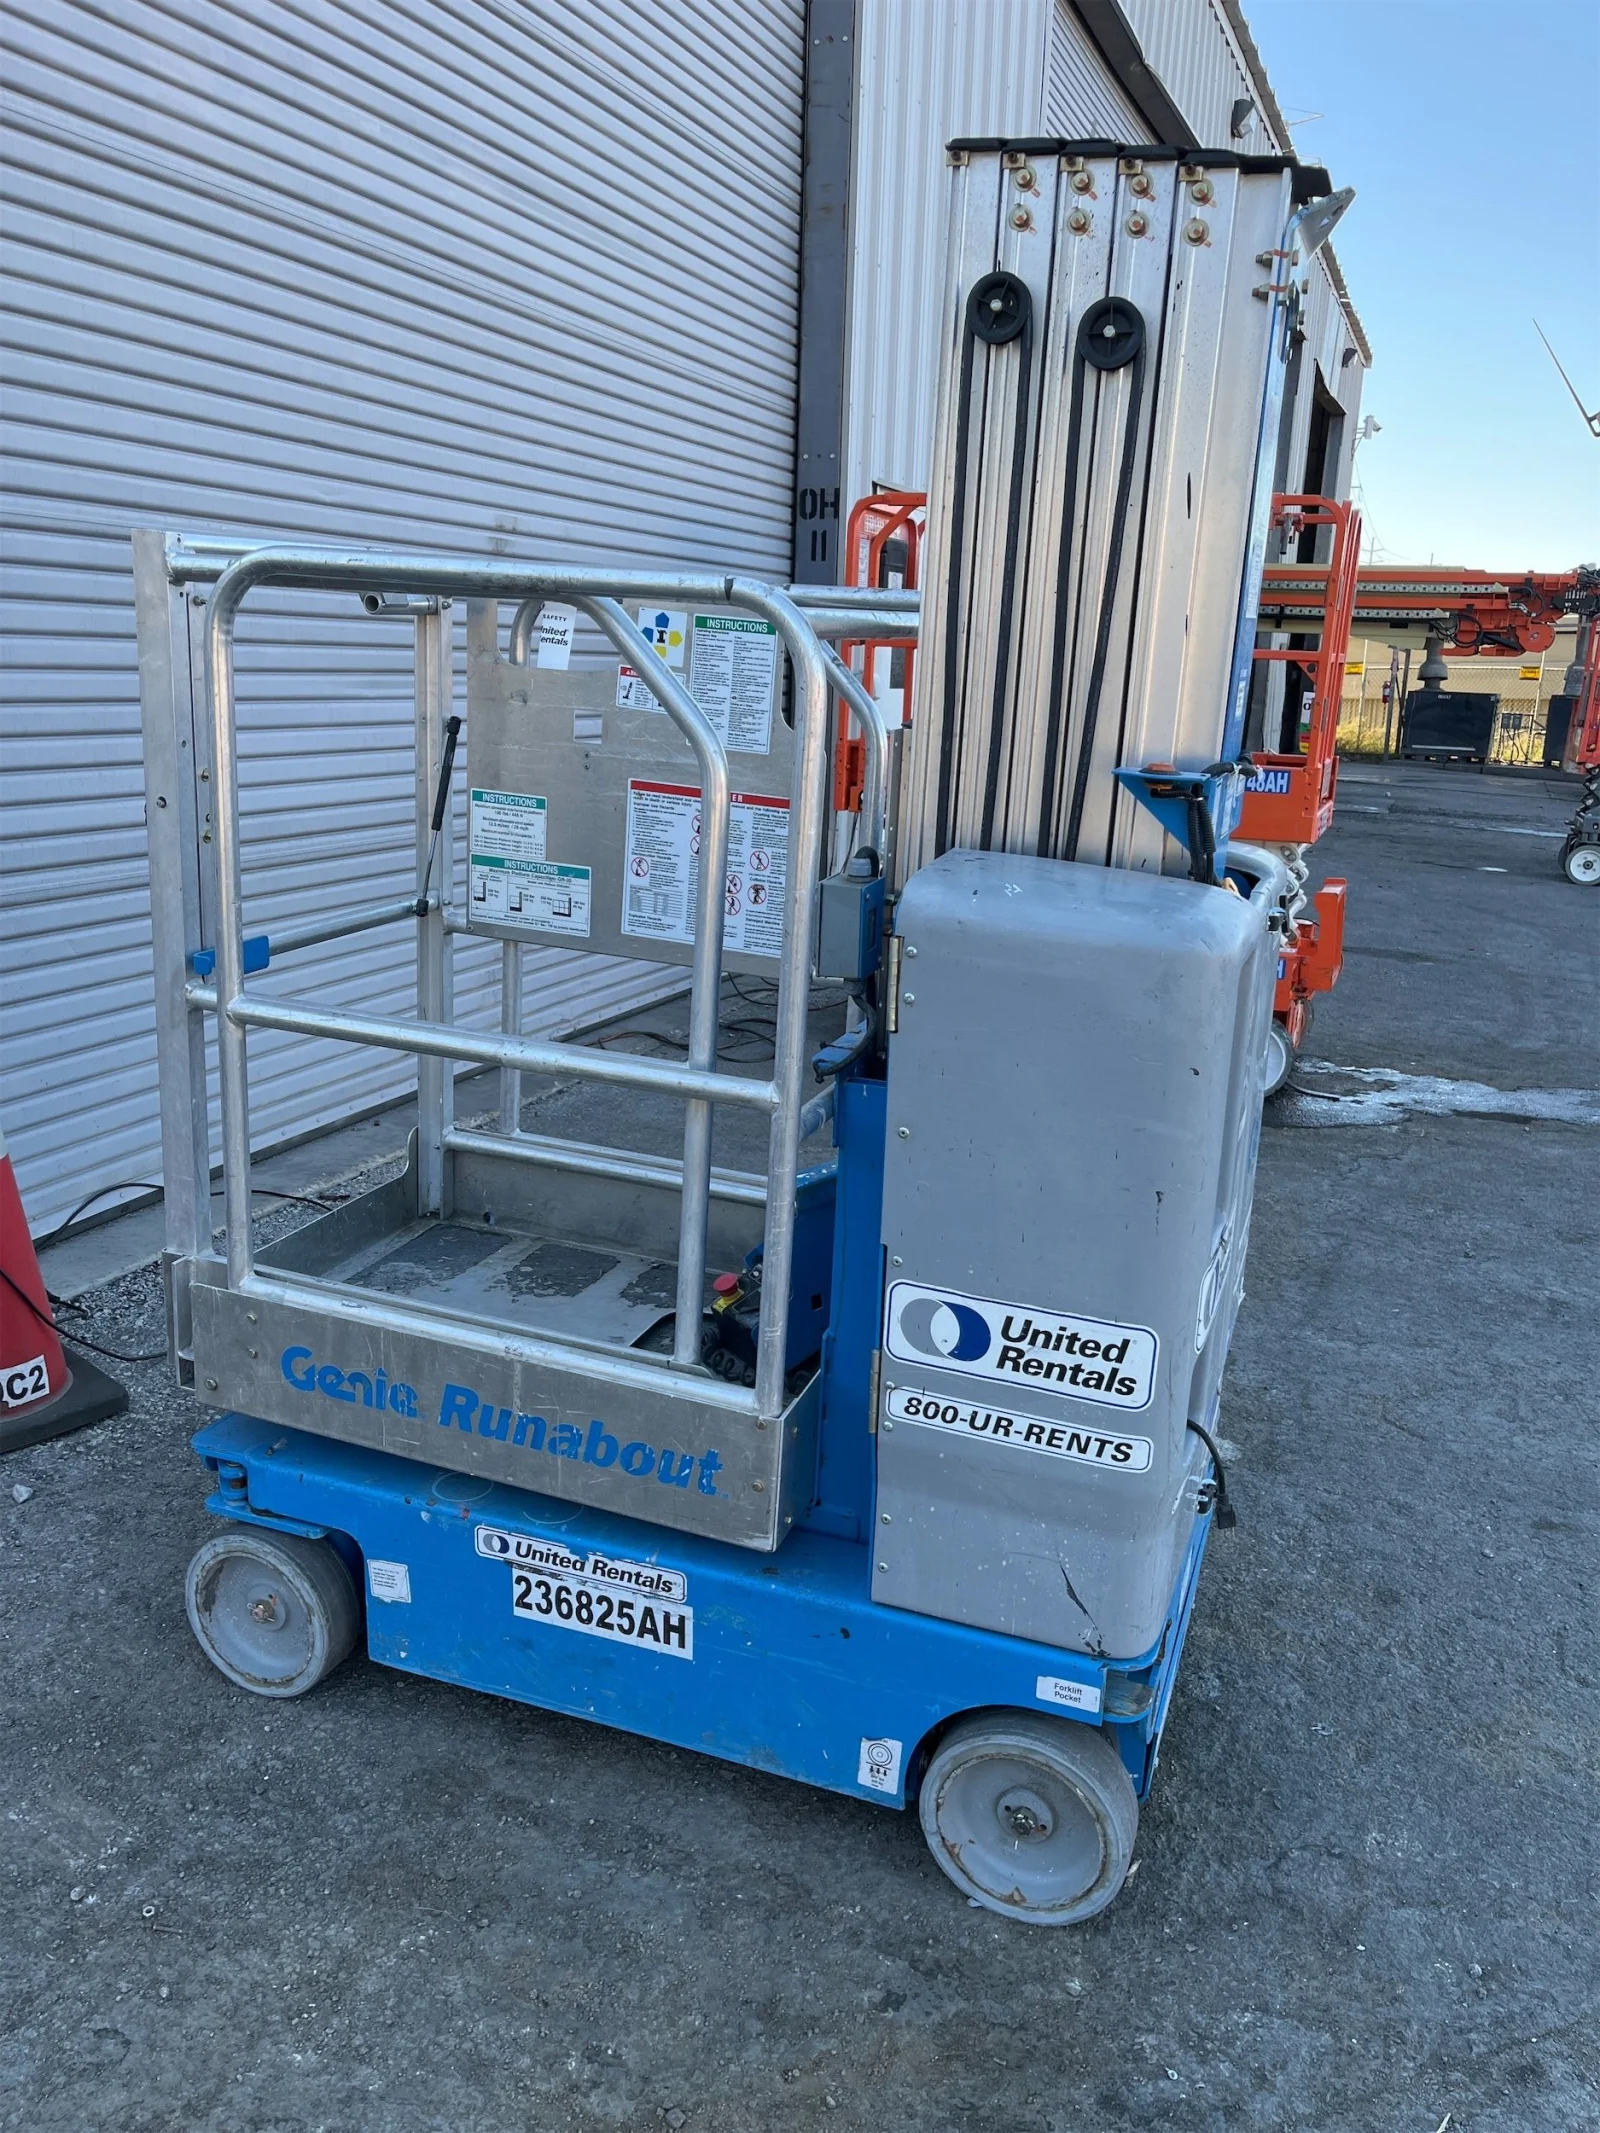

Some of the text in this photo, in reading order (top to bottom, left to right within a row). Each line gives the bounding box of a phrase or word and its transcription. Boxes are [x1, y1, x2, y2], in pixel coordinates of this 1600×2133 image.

[799, 488, 840, 520] OH
[542, 613, 568, 622] SAFETY
[707, 618, 768, 633] INSTRUCTIONS
[540, 636, 569, 647] entals
[482, 793, 538, 808] INSTRUCTIONS
[504, 860, 558, 874] INSTRUCTIONS
[1000, 1315, 1131, 1364] United
[0, 1364, 46, 1401] C2
[996, 1345, 1137, 1397] Rentals
[280, 1345, 724, 1497] Genie Runabout
[903, 1396, 1134, 1463] 800-UR-RENTS
[515, 1540, 673, 1593] United Rentals
[514, 1575, 686, 1650] 236825AH
[1053, 1682, 1083, 1696] Forklift
[1054, 1690, 1082, 1704] Pocket
